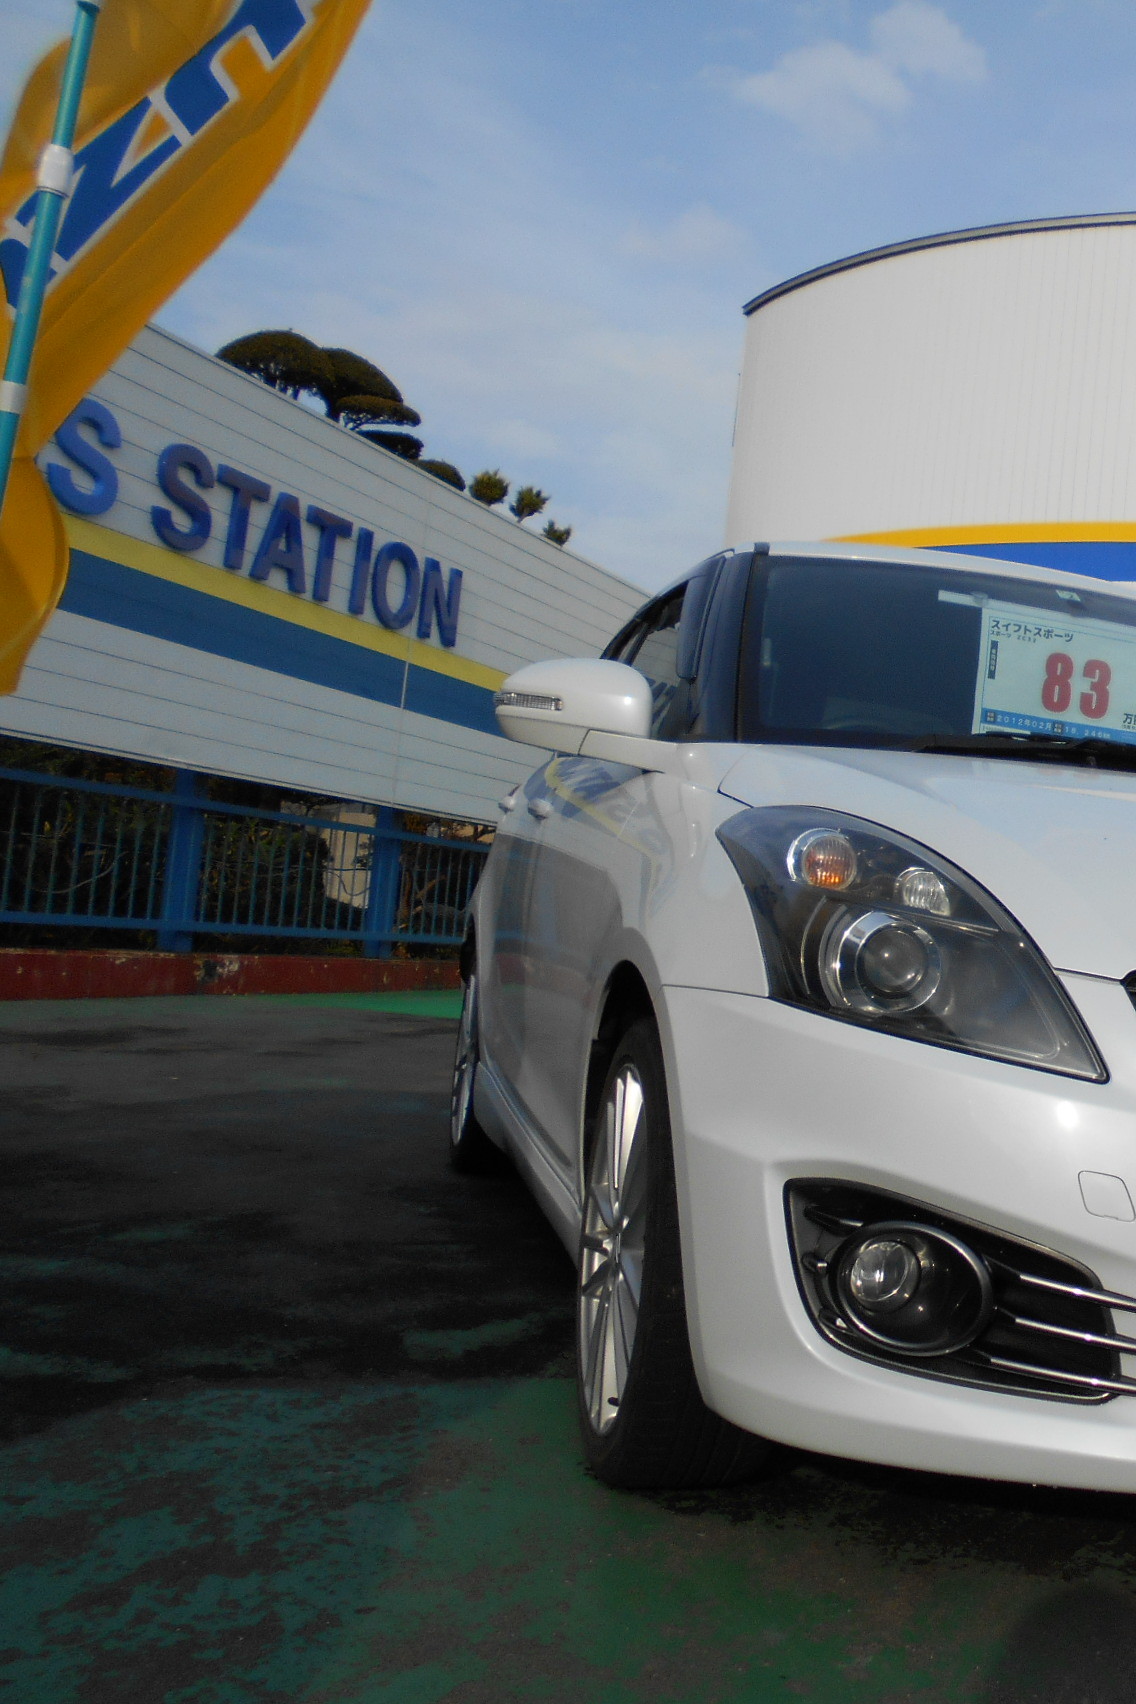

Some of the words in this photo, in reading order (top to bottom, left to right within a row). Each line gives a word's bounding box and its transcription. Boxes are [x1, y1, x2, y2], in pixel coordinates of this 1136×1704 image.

[150, 443, 464, 649] STATION
[991, 619, 1074, 643] スイフトスポーツ
[1041, 652, 1112, 720] 83
